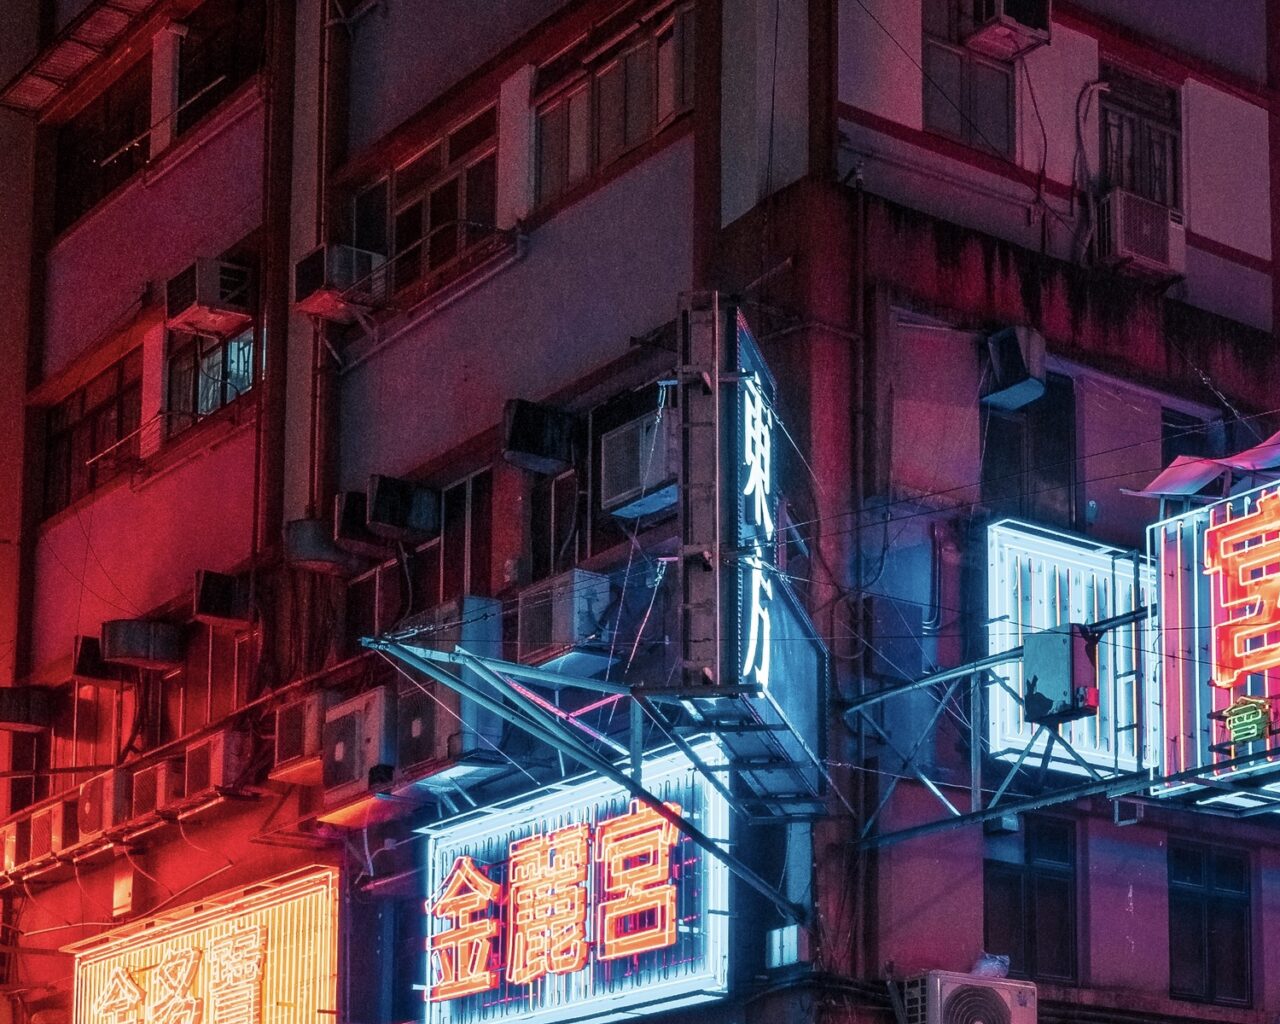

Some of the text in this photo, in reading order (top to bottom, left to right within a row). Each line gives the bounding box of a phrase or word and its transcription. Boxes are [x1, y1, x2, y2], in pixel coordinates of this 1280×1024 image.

[742, 367, 774, 698] 東方
[425, 799, 682, 1003] 金麗宮
